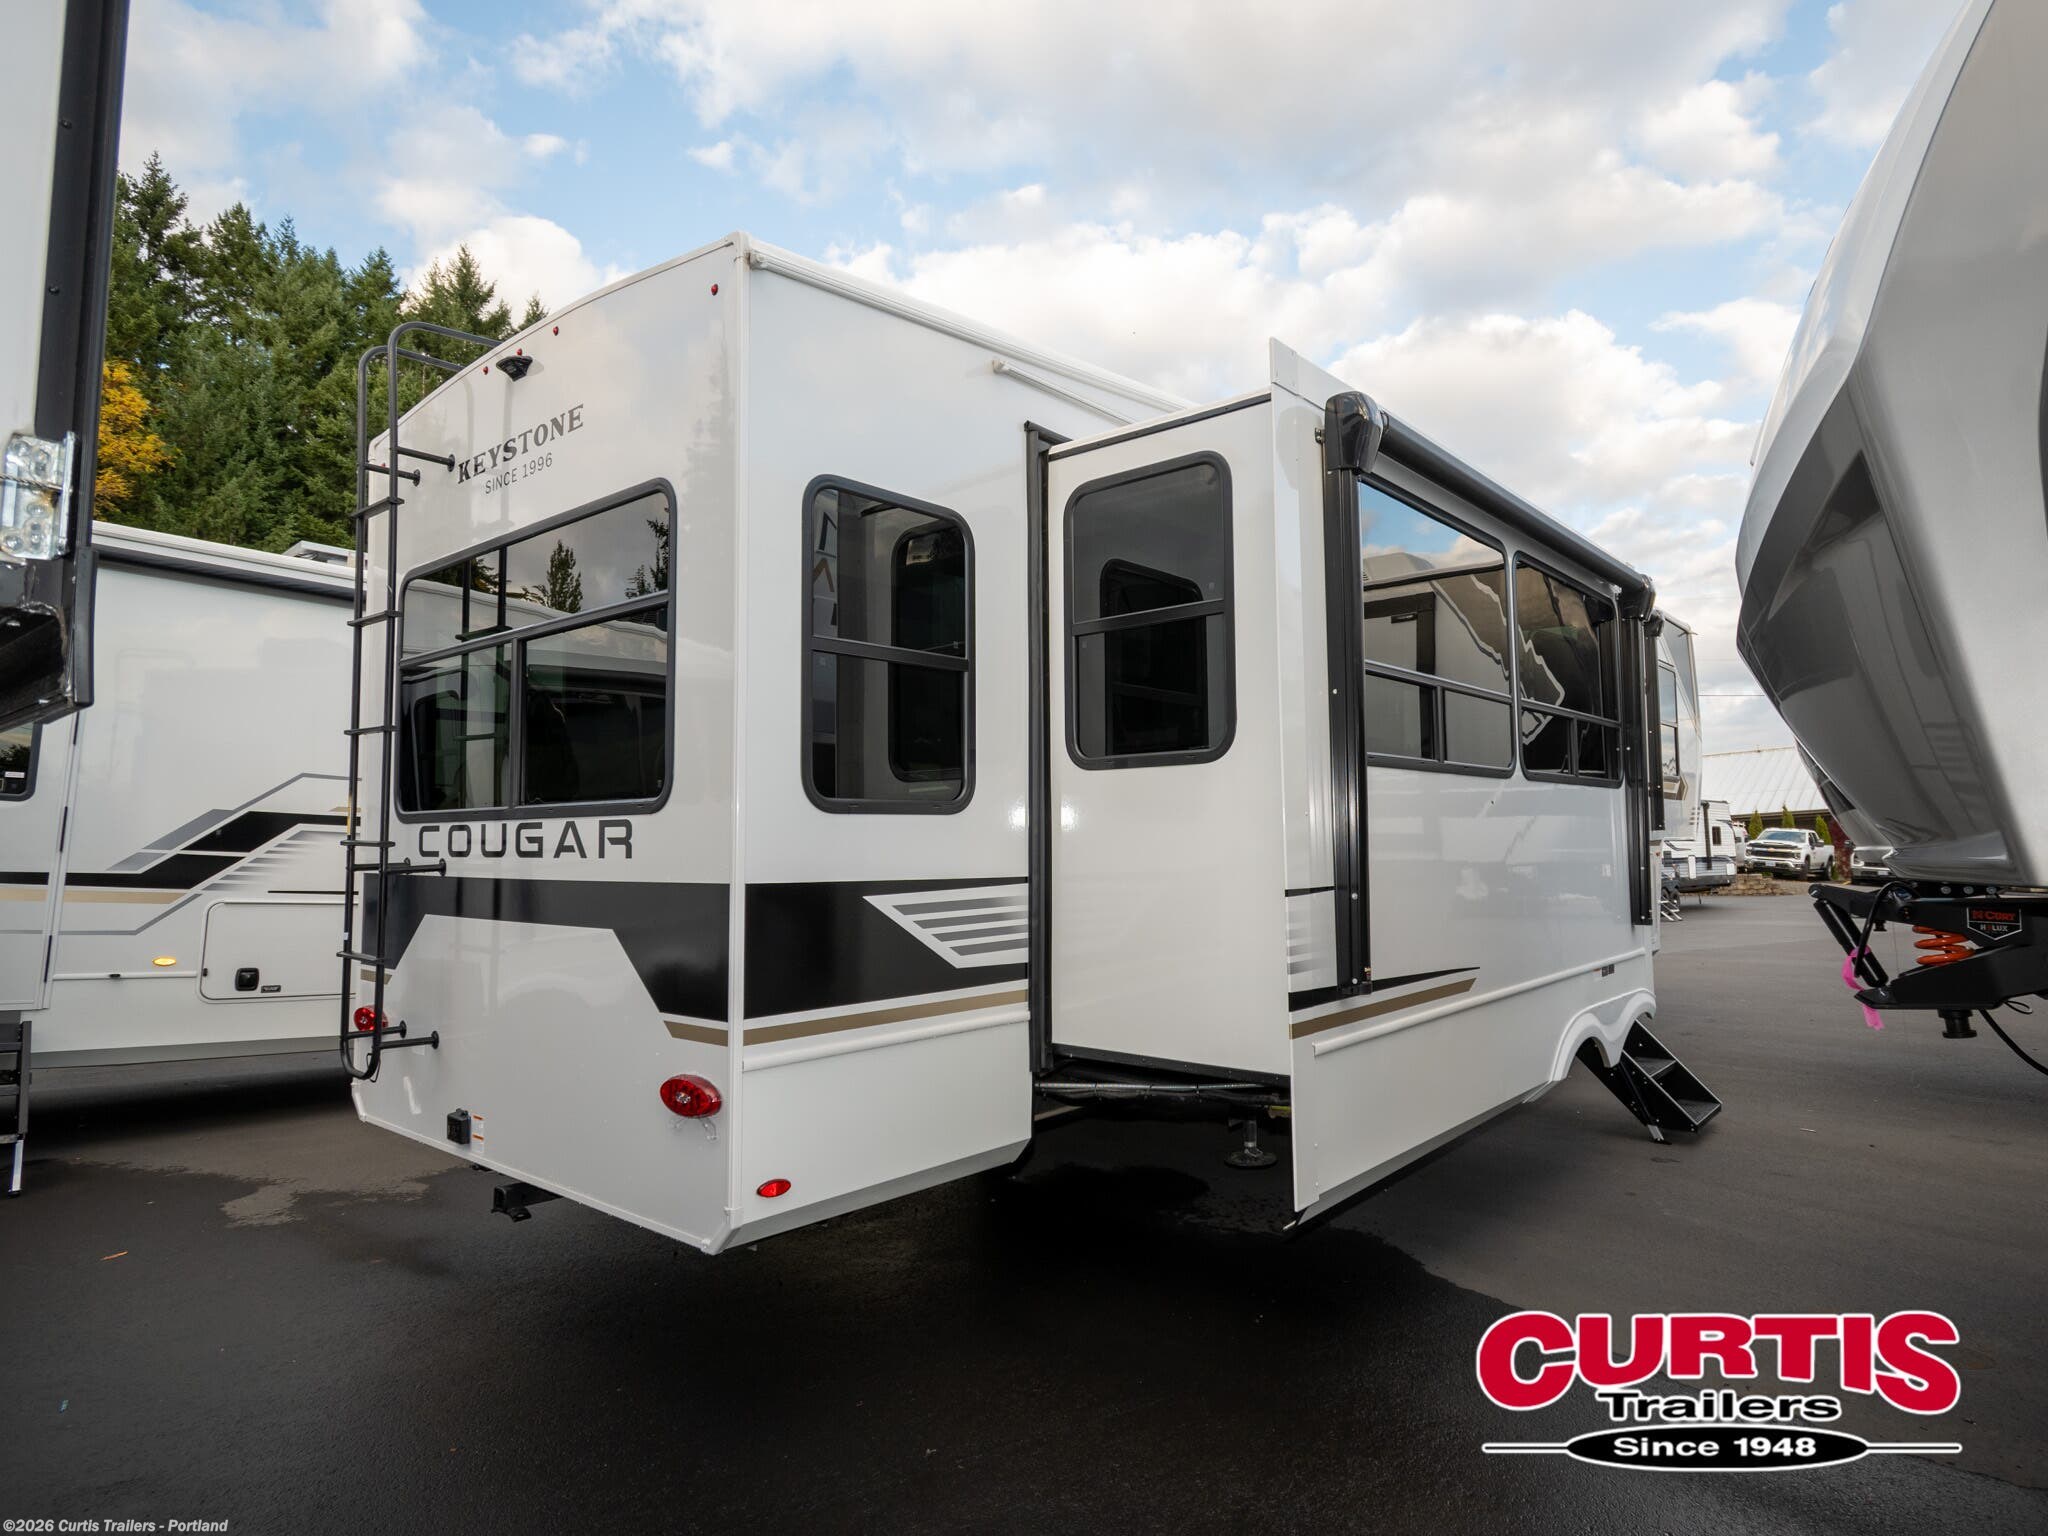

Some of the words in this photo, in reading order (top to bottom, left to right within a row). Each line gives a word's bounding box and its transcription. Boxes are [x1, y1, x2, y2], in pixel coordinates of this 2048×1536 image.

[457, 404, 584, 485] KEYSTONE
[485, 468, 518, 494] SINCE
[523, 452, 553, 479] 1996
[418, 818, 633, 860] COUGAR
